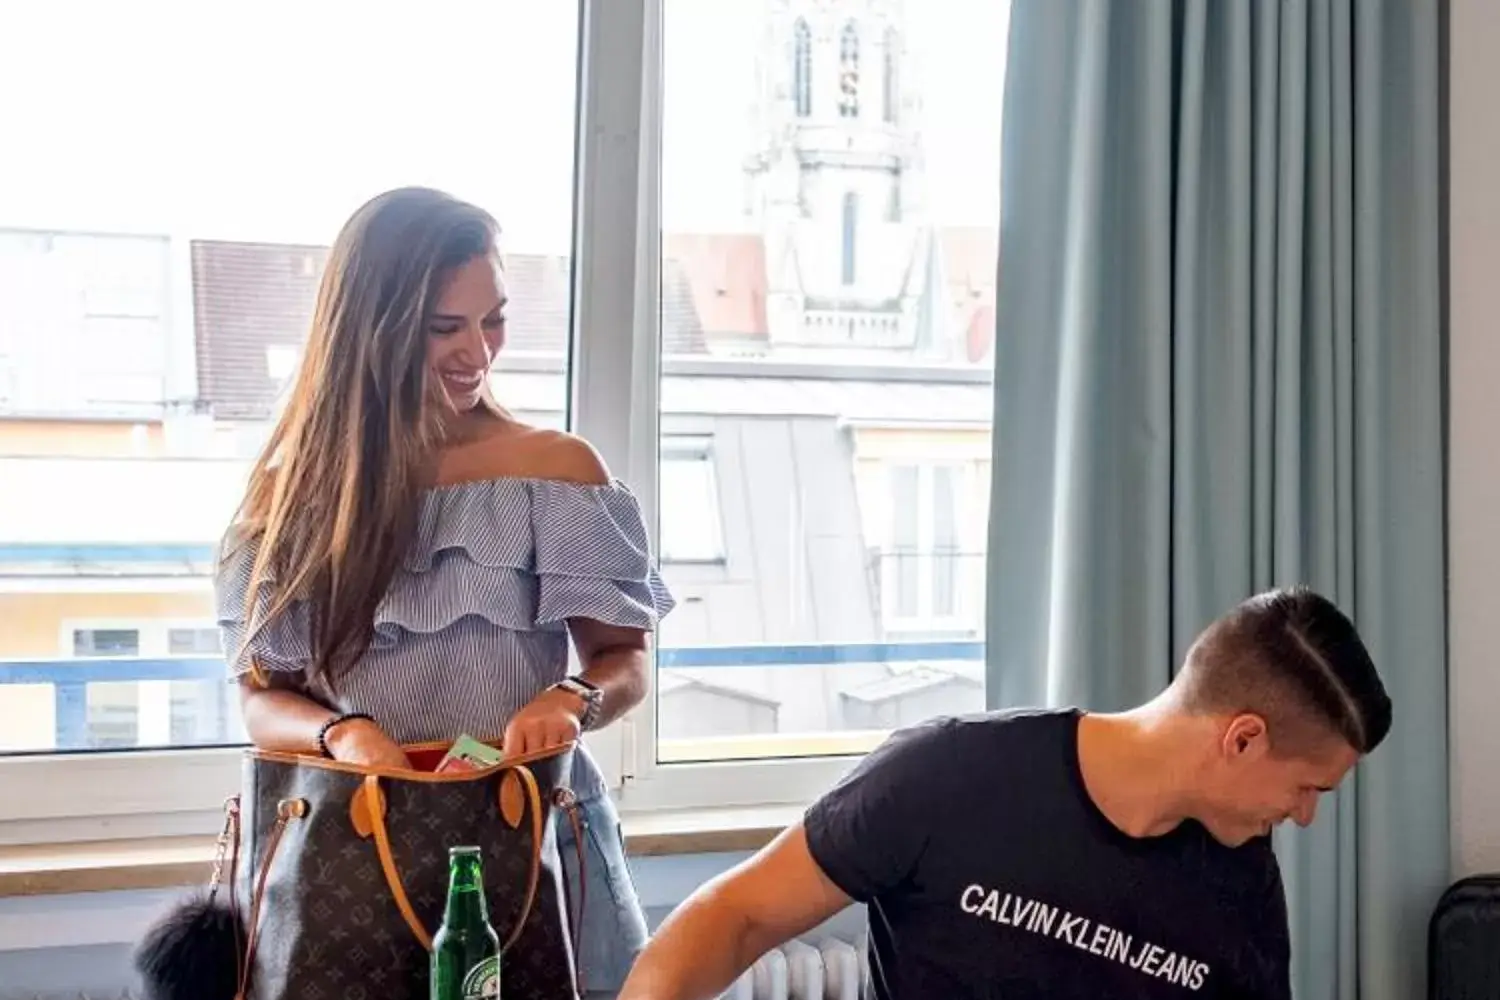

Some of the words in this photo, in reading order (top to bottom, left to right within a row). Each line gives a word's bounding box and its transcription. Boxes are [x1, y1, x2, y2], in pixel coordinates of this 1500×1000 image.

[960, 884, 1059, 937] CALVIN
[1054, 911, 1133, 964] KLEIN
[1129, 942, 1210, 991] JEANS
